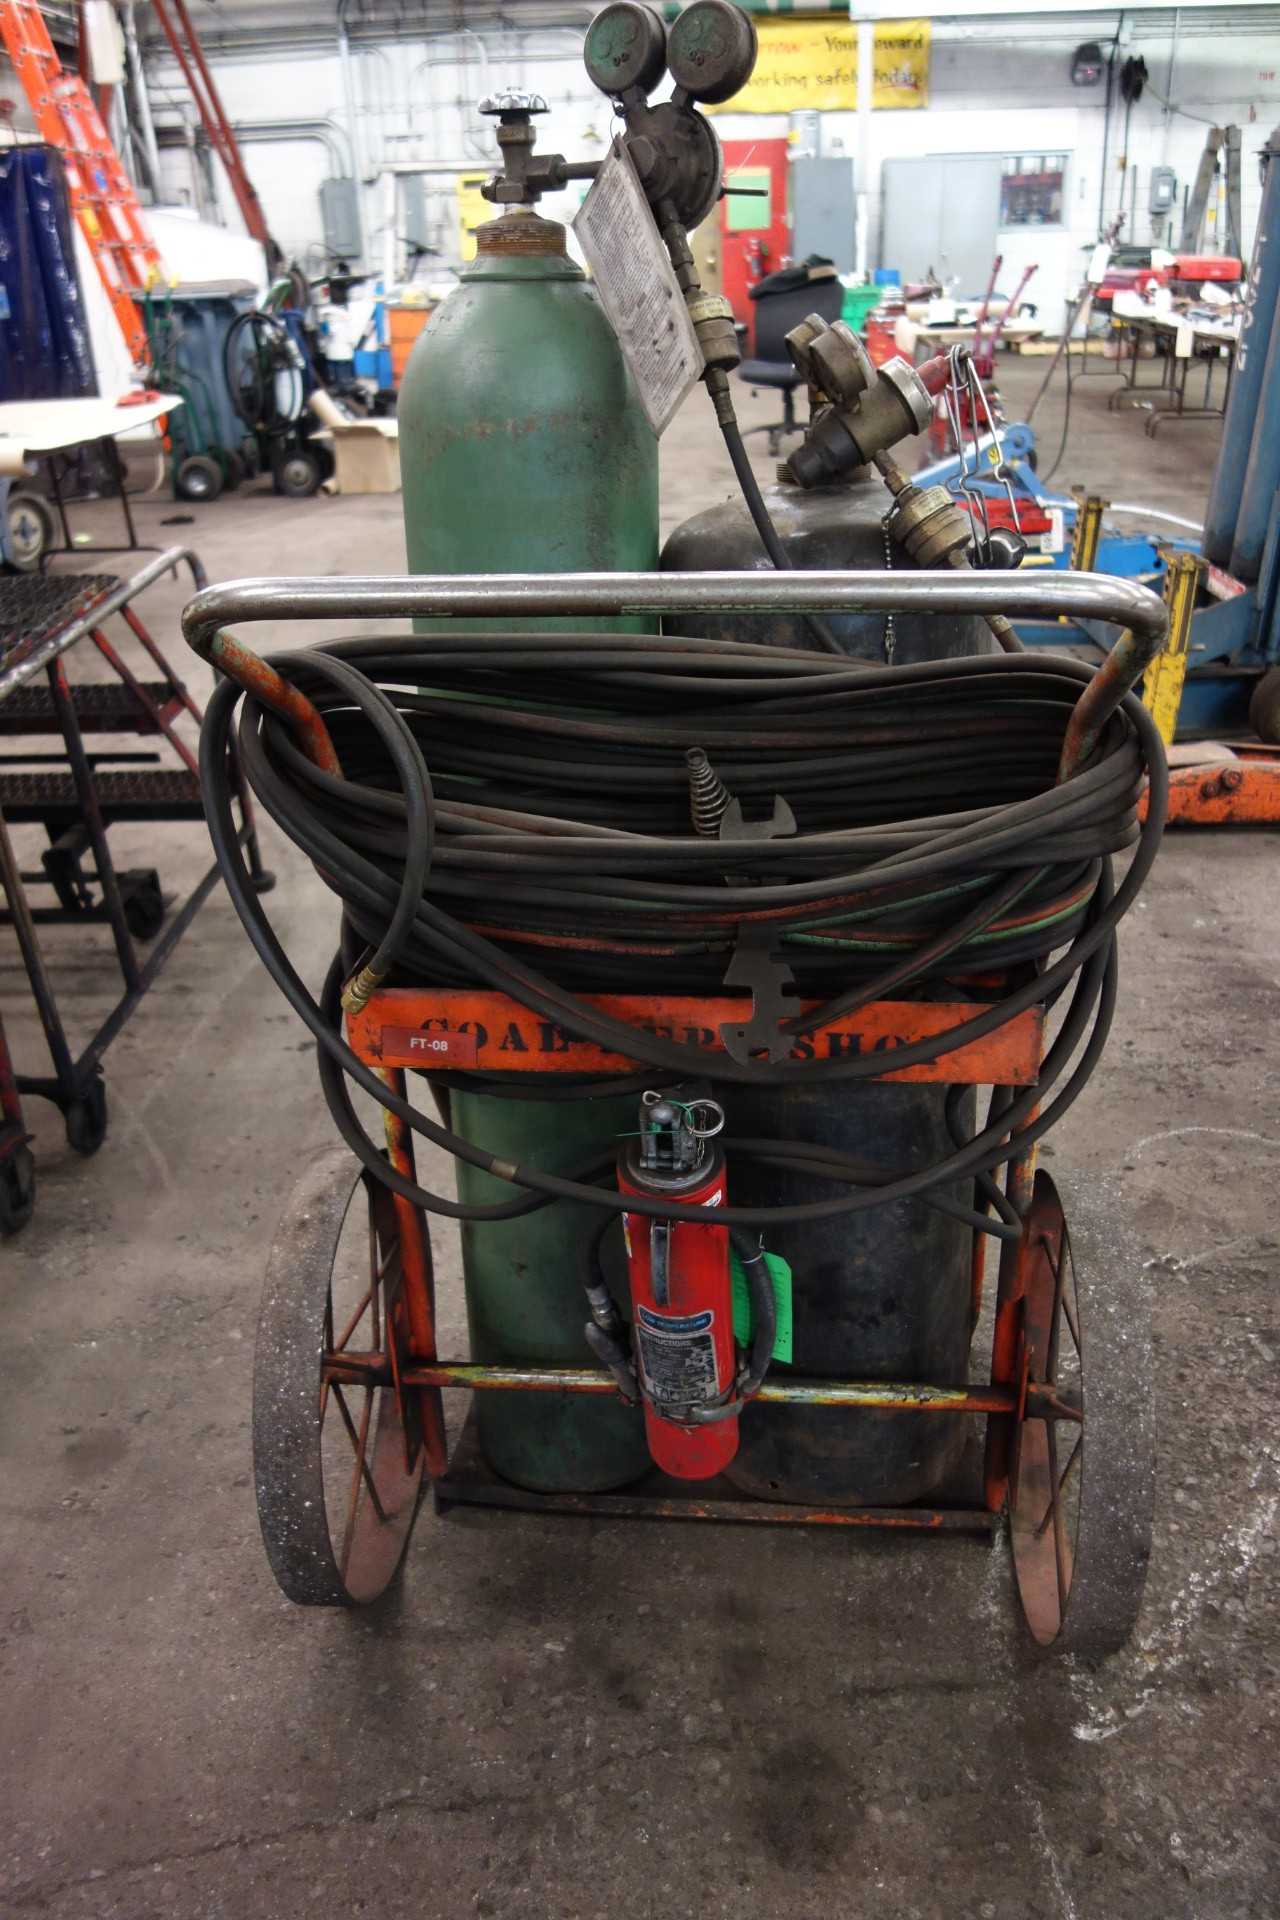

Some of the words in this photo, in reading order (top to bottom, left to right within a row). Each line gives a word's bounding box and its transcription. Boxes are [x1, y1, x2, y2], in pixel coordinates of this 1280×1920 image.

[873, 33, 923, 50] eward
[815, 66, 858, 87] safel
[410, 1037, 448, 1051] FT-08
